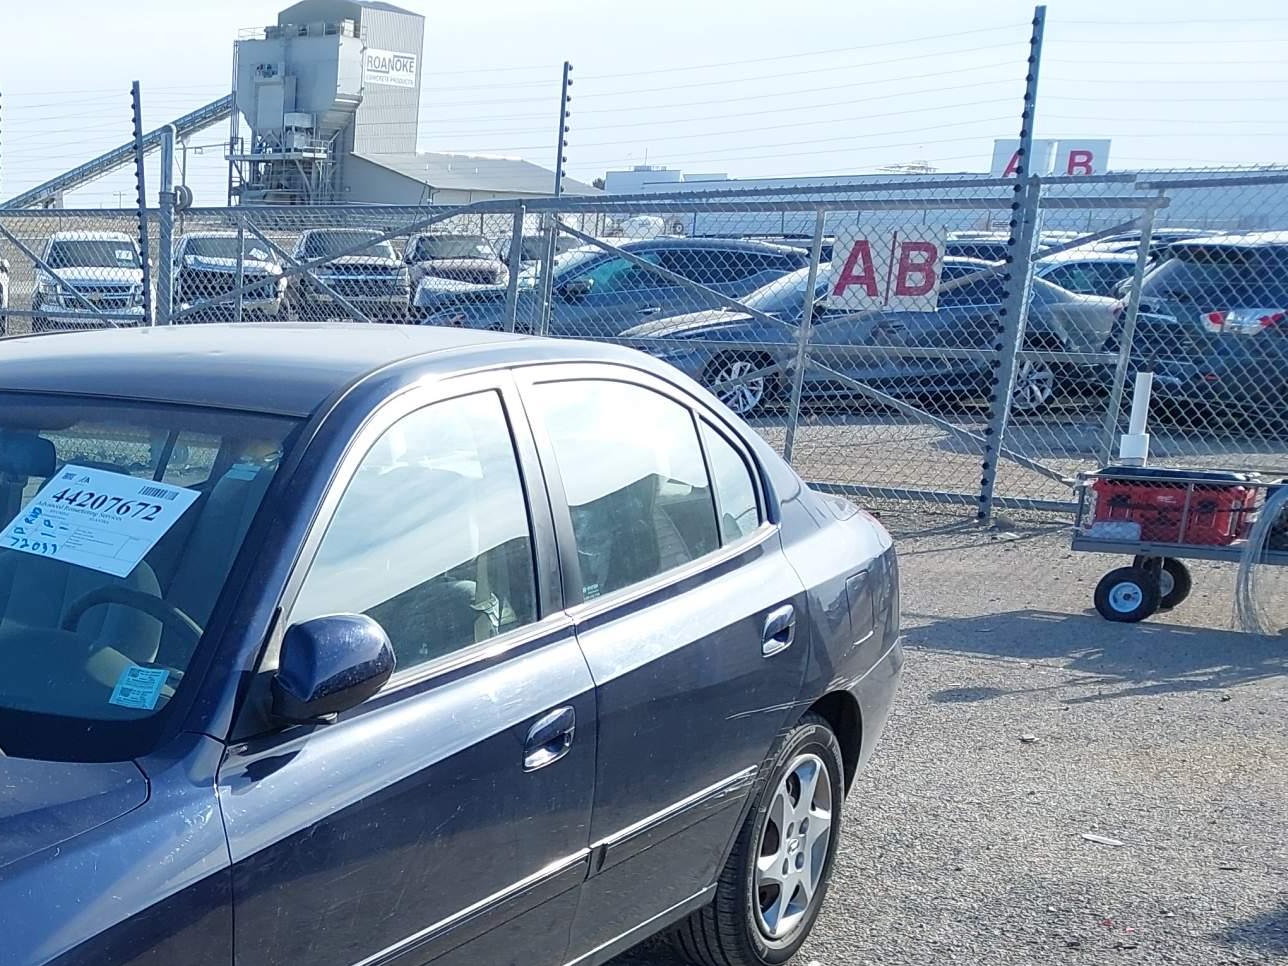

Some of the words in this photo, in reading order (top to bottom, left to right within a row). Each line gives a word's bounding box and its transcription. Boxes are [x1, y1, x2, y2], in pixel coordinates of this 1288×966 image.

[367, 55, 415, 73] ROANOKE
[1067, 150, 1094, 176] B
[52, 487, 162, 521] 44207672
